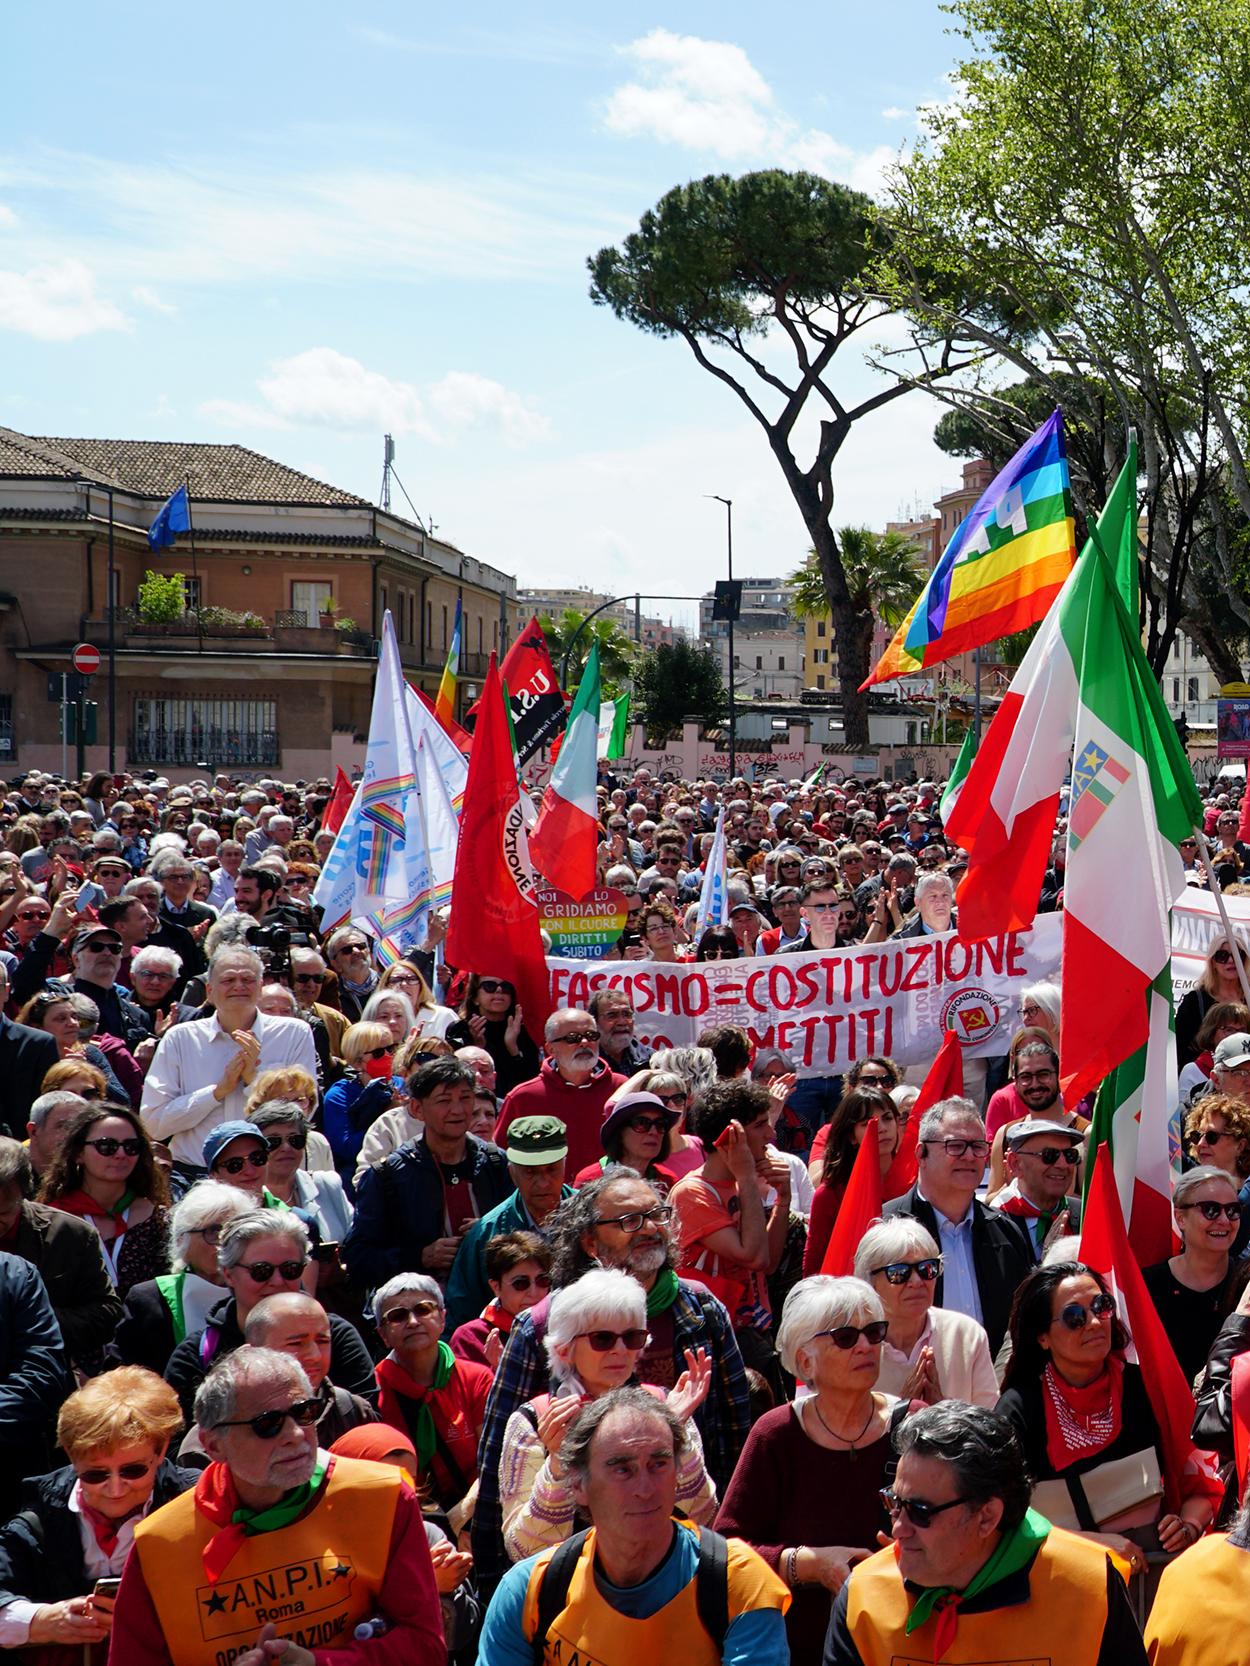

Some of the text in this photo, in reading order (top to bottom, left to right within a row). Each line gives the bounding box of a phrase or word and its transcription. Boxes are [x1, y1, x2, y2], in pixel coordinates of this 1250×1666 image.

[538, 891, 609, 902] NOI LO
[543, 903, 617, 918] GRIDIAMO
[568, 920, 577, 930] IL
[579, 918, 617, 930] CUORE
[559, 933, 607, 944] DIRITTI
[562, 945, 602, 957] SUBITO
[948, 991, 998, 1017] RIFONDAZIONE
[231, 1561, 331, 1613] A.N.P.I.
[255, 1600, 305, 1624] Roma
